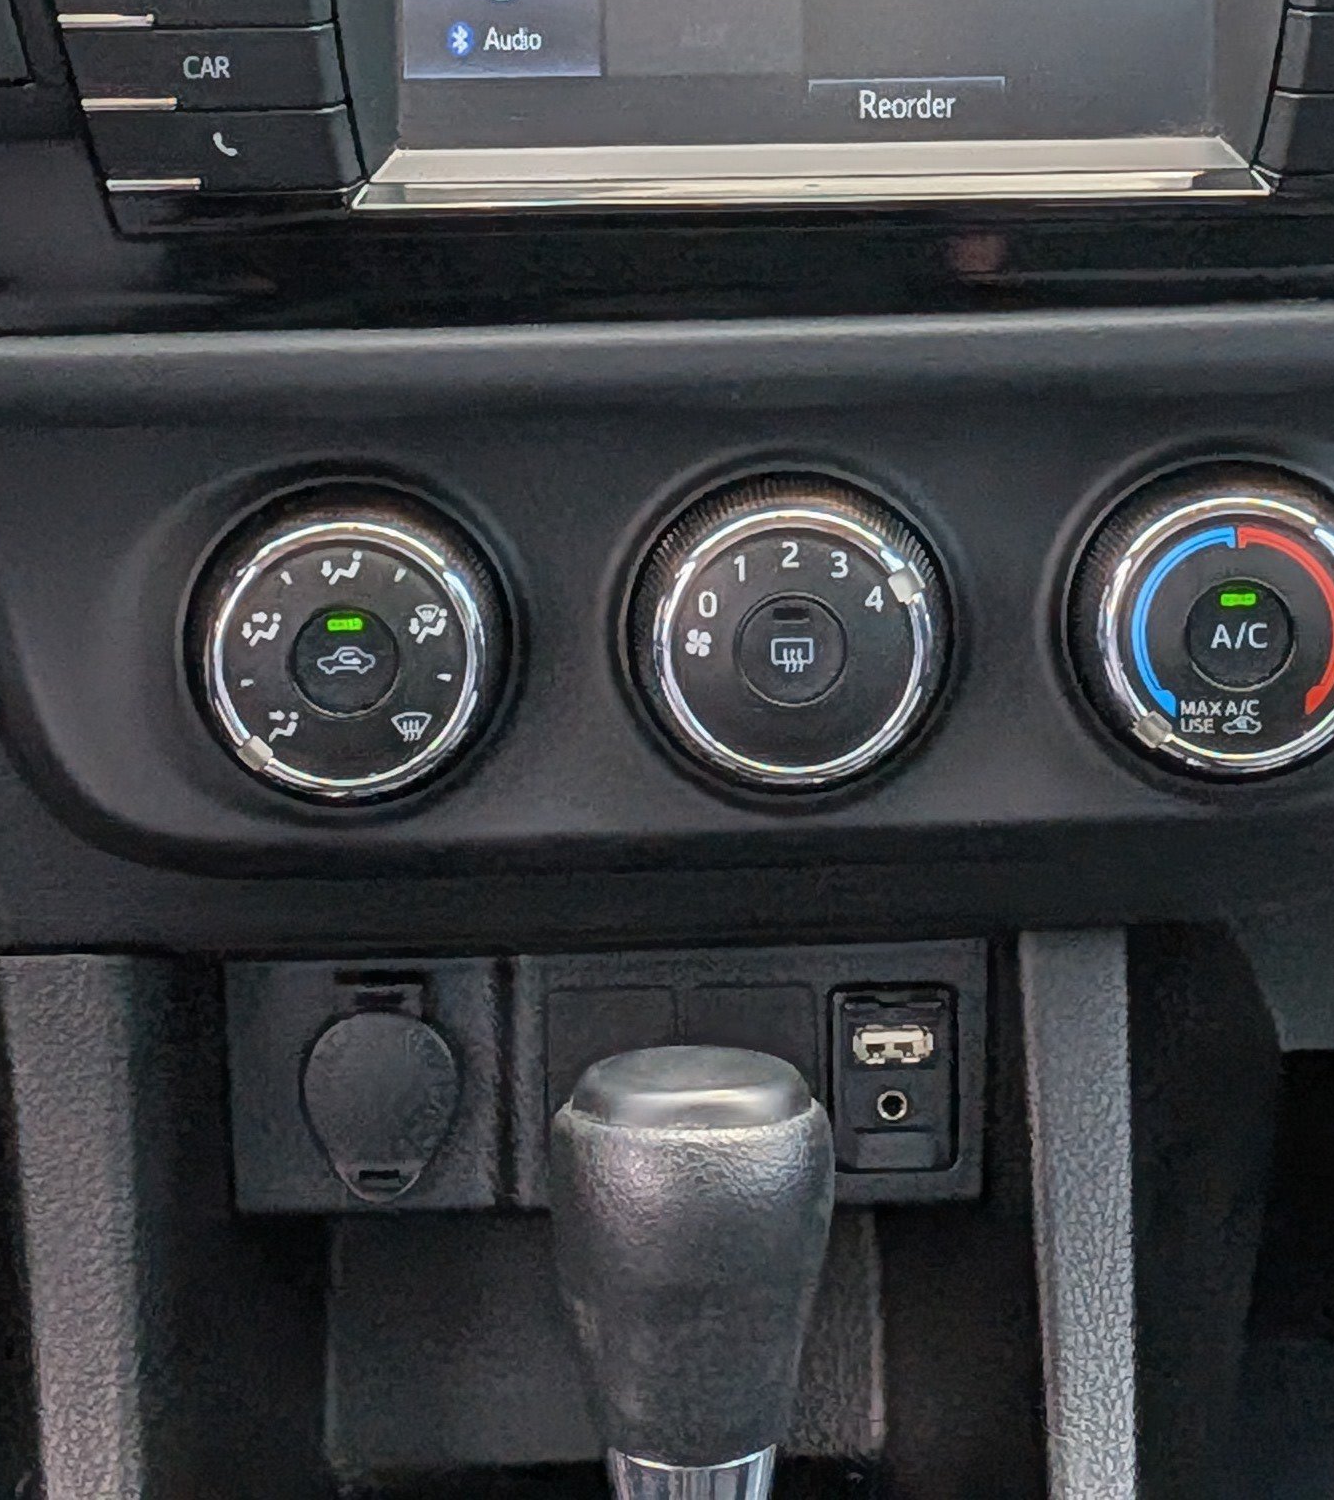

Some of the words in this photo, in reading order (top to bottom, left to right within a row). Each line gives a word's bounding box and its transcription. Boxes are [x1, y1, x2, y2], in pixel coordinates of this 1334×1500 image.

[483, 27, 542, 52] Audio
[182, 56, 230, 80] CAR
[858, 89, 956, 120] Reorder
[733, 554, 746, 582] 1
[781, 541, 800, 568] 2
[830, 550, 849, 579] 3
[698, 590, 718, 618] 0
[864, 585, 884, 612] 4
[1210, 621, 1269, 649] A/C
[1180, 700, 1221, 717] MAX
[1225, 699, 1260, 717] A/C
[1180, 718, 1215, 734] USE
